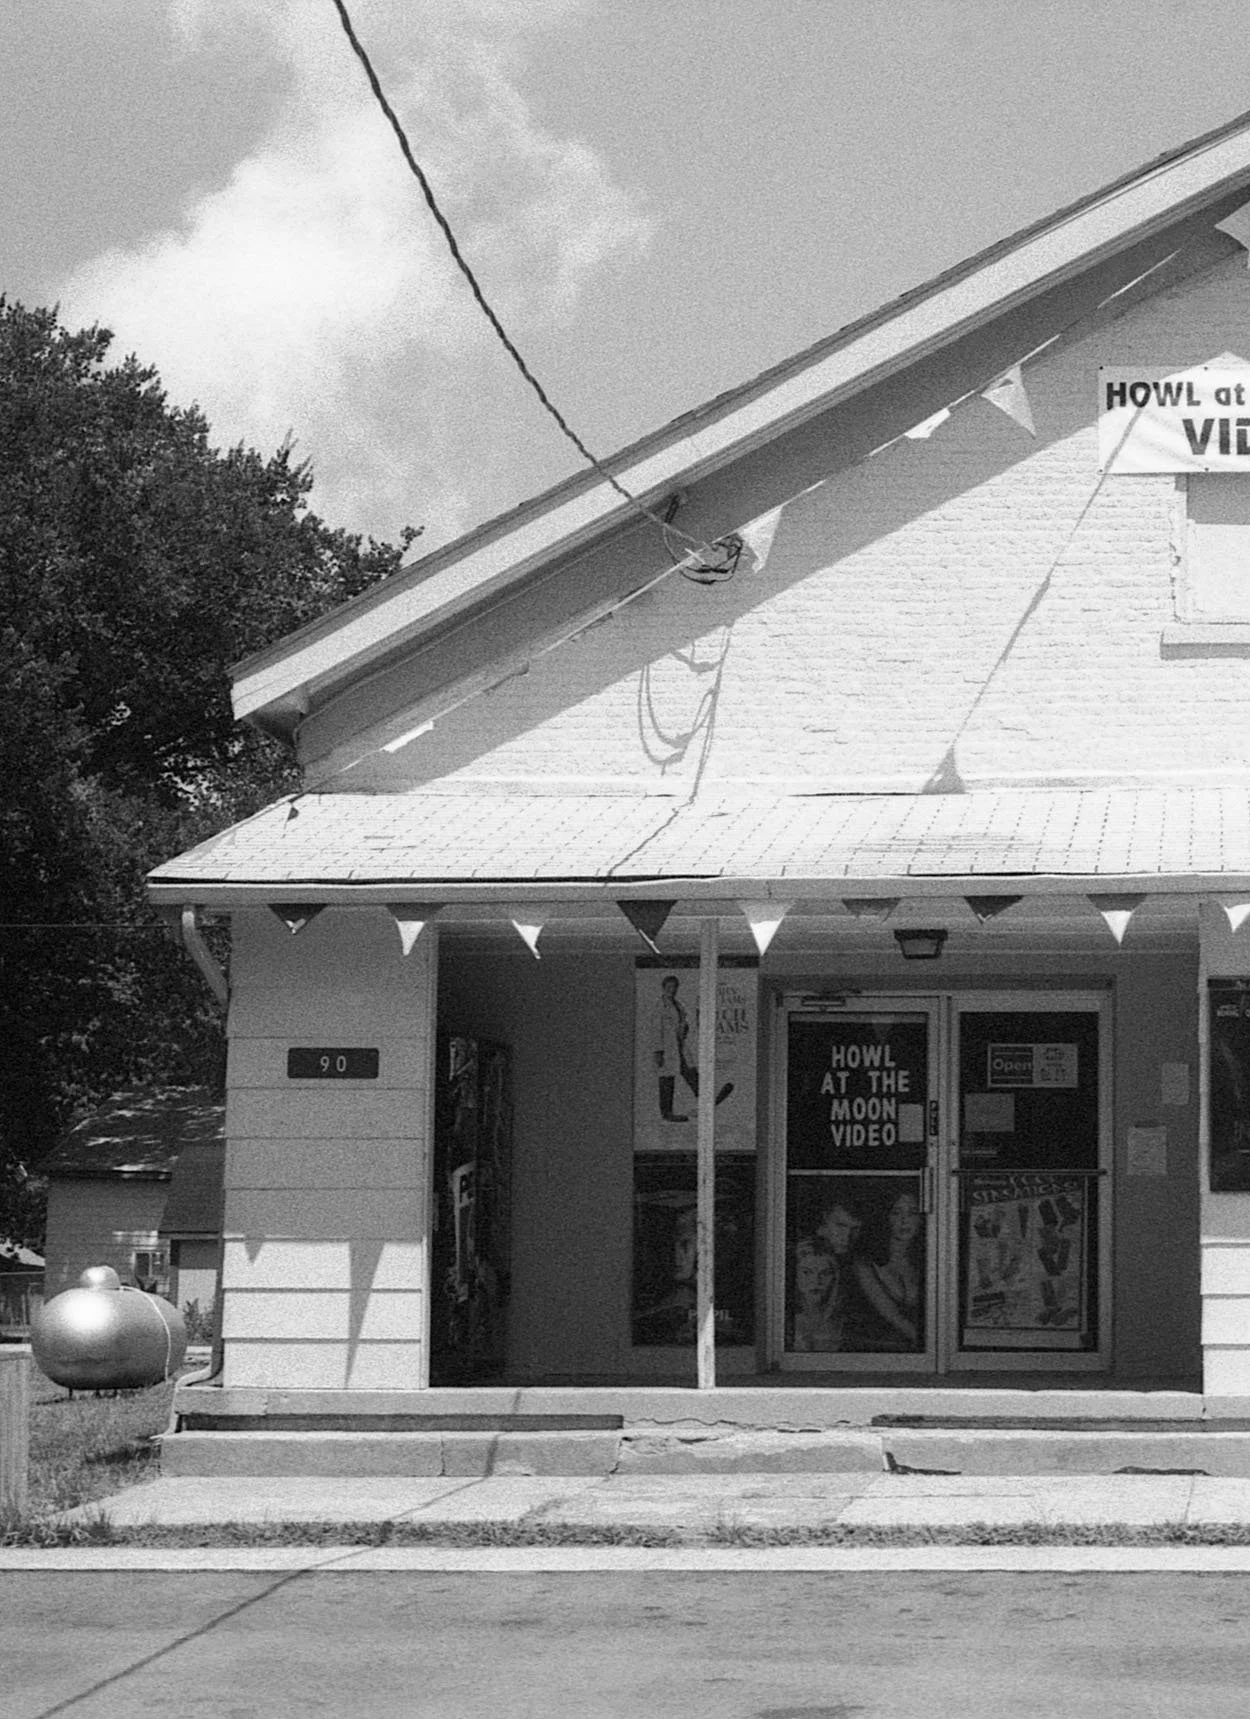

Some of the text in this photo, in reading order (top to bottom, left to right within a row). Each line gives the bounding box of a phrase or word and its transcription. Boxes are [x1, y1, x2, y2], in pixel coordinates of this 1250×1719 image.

[1106, 381, 1201, 409] HOWL
[1214, 383, 1245, 406] at
[319, 1055, 348, 1073] 90
[832, 1044, 897, 1069] HOWL
[992, 1057, 1033, 1073] Open
[820, 1070, 911, 1095] AT THE
[830, 1096, 897, 1122] MOON
[830, 1123, 897, 1148] VIDEO
